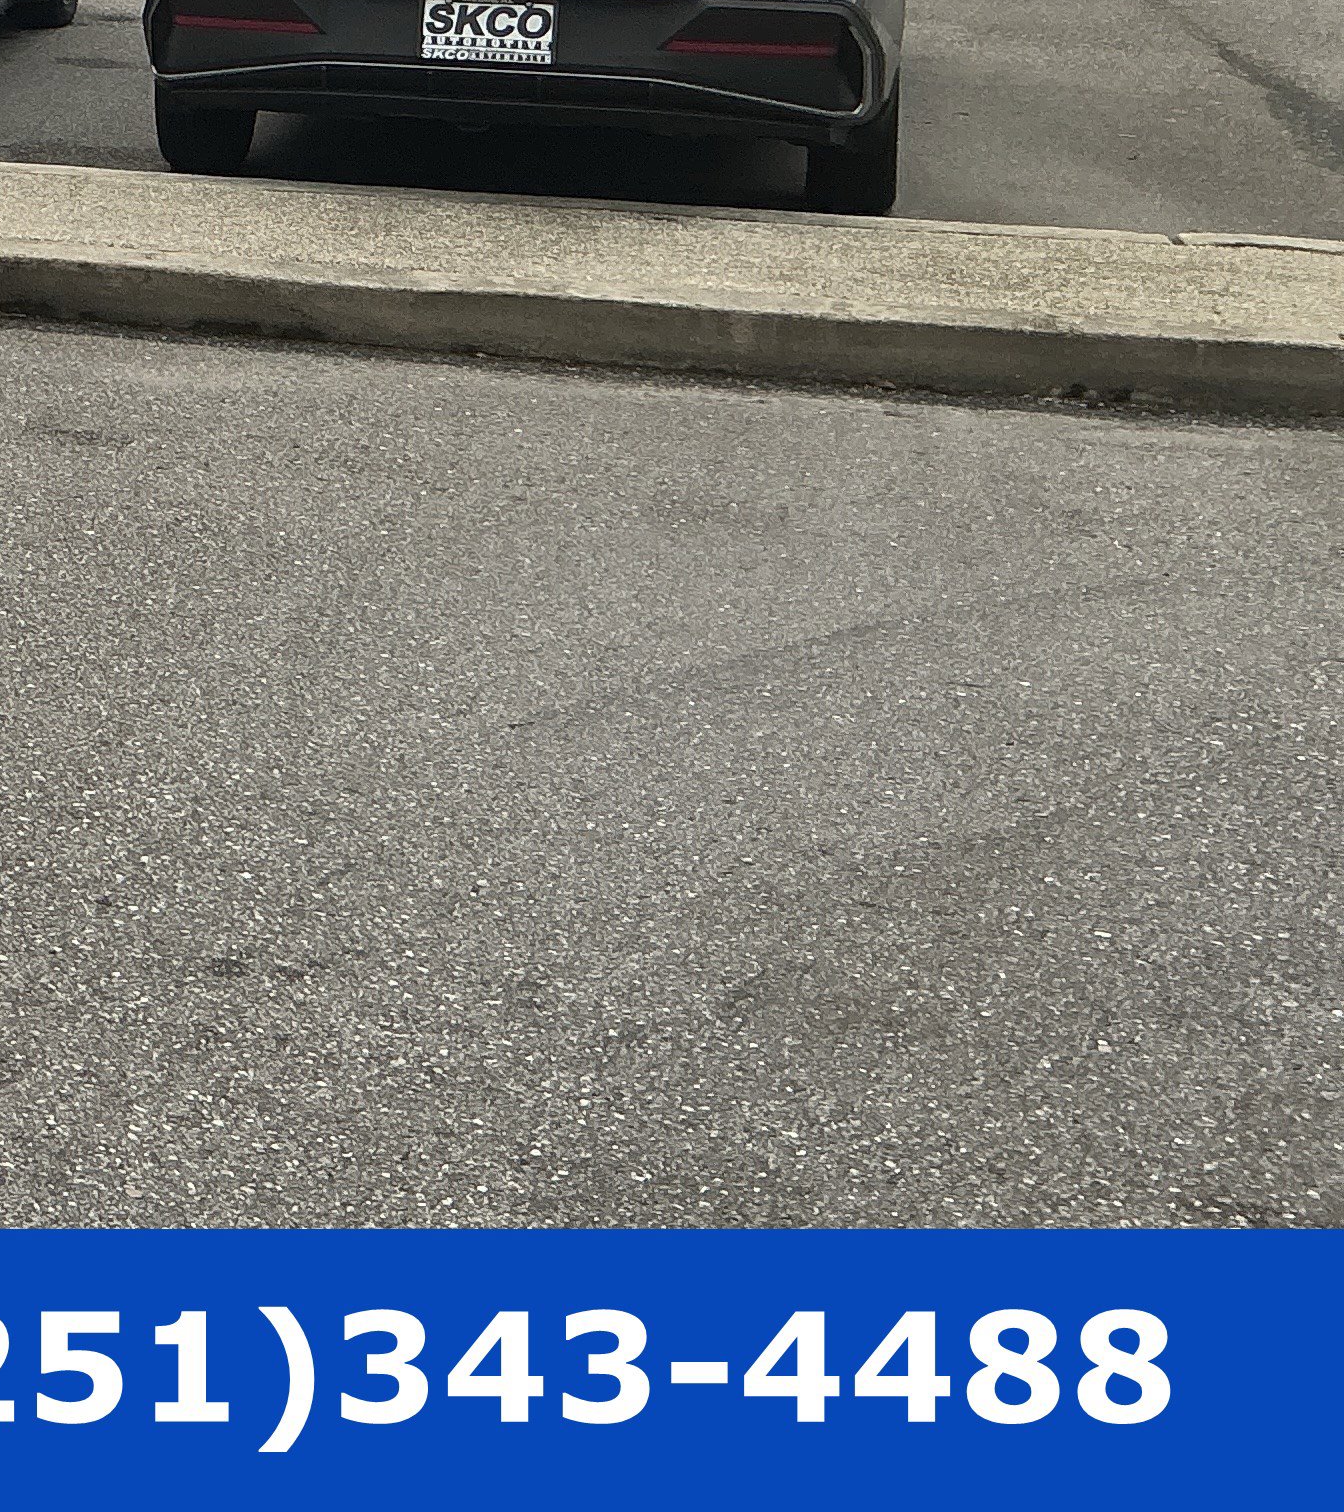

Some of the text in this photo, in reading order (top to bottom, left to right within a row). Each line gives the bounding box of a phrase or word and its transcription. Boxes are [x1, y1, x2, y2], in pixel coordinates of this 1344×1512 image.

[425, 3, 552, 39] SKCO
[422, 36, 551, 50] AUTOMOTIVE
[421, 48, 468, 60] SKCO
